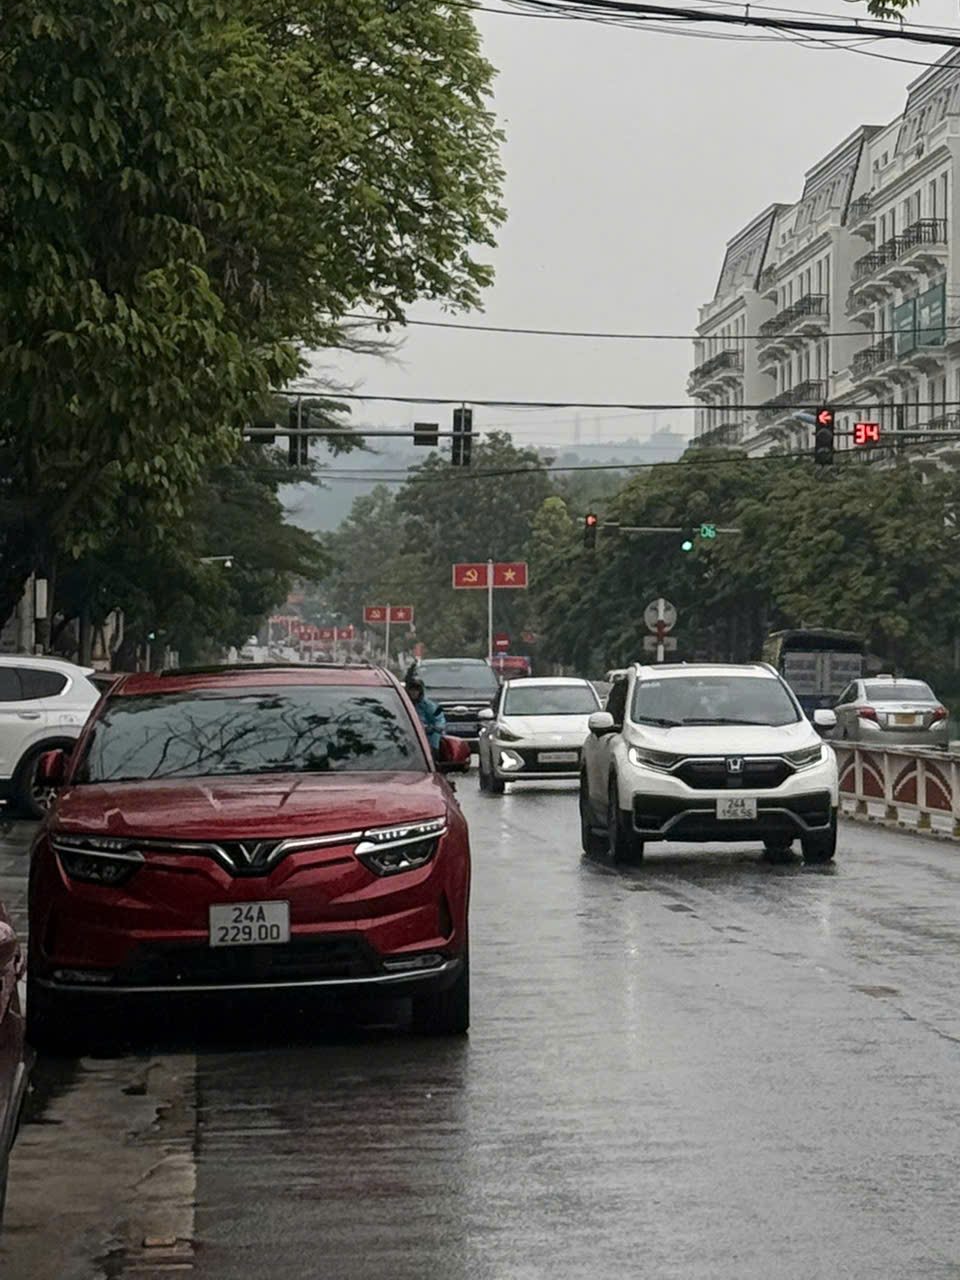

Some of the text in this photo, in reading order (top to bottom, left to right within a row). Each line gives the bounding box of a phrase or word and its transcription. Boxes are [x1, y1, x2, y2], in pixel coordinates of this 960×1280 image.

[855, 424, 879, 443] 34
[232, 905, 266, 923] 24A
[217, 923, 280, 942] 229.00
